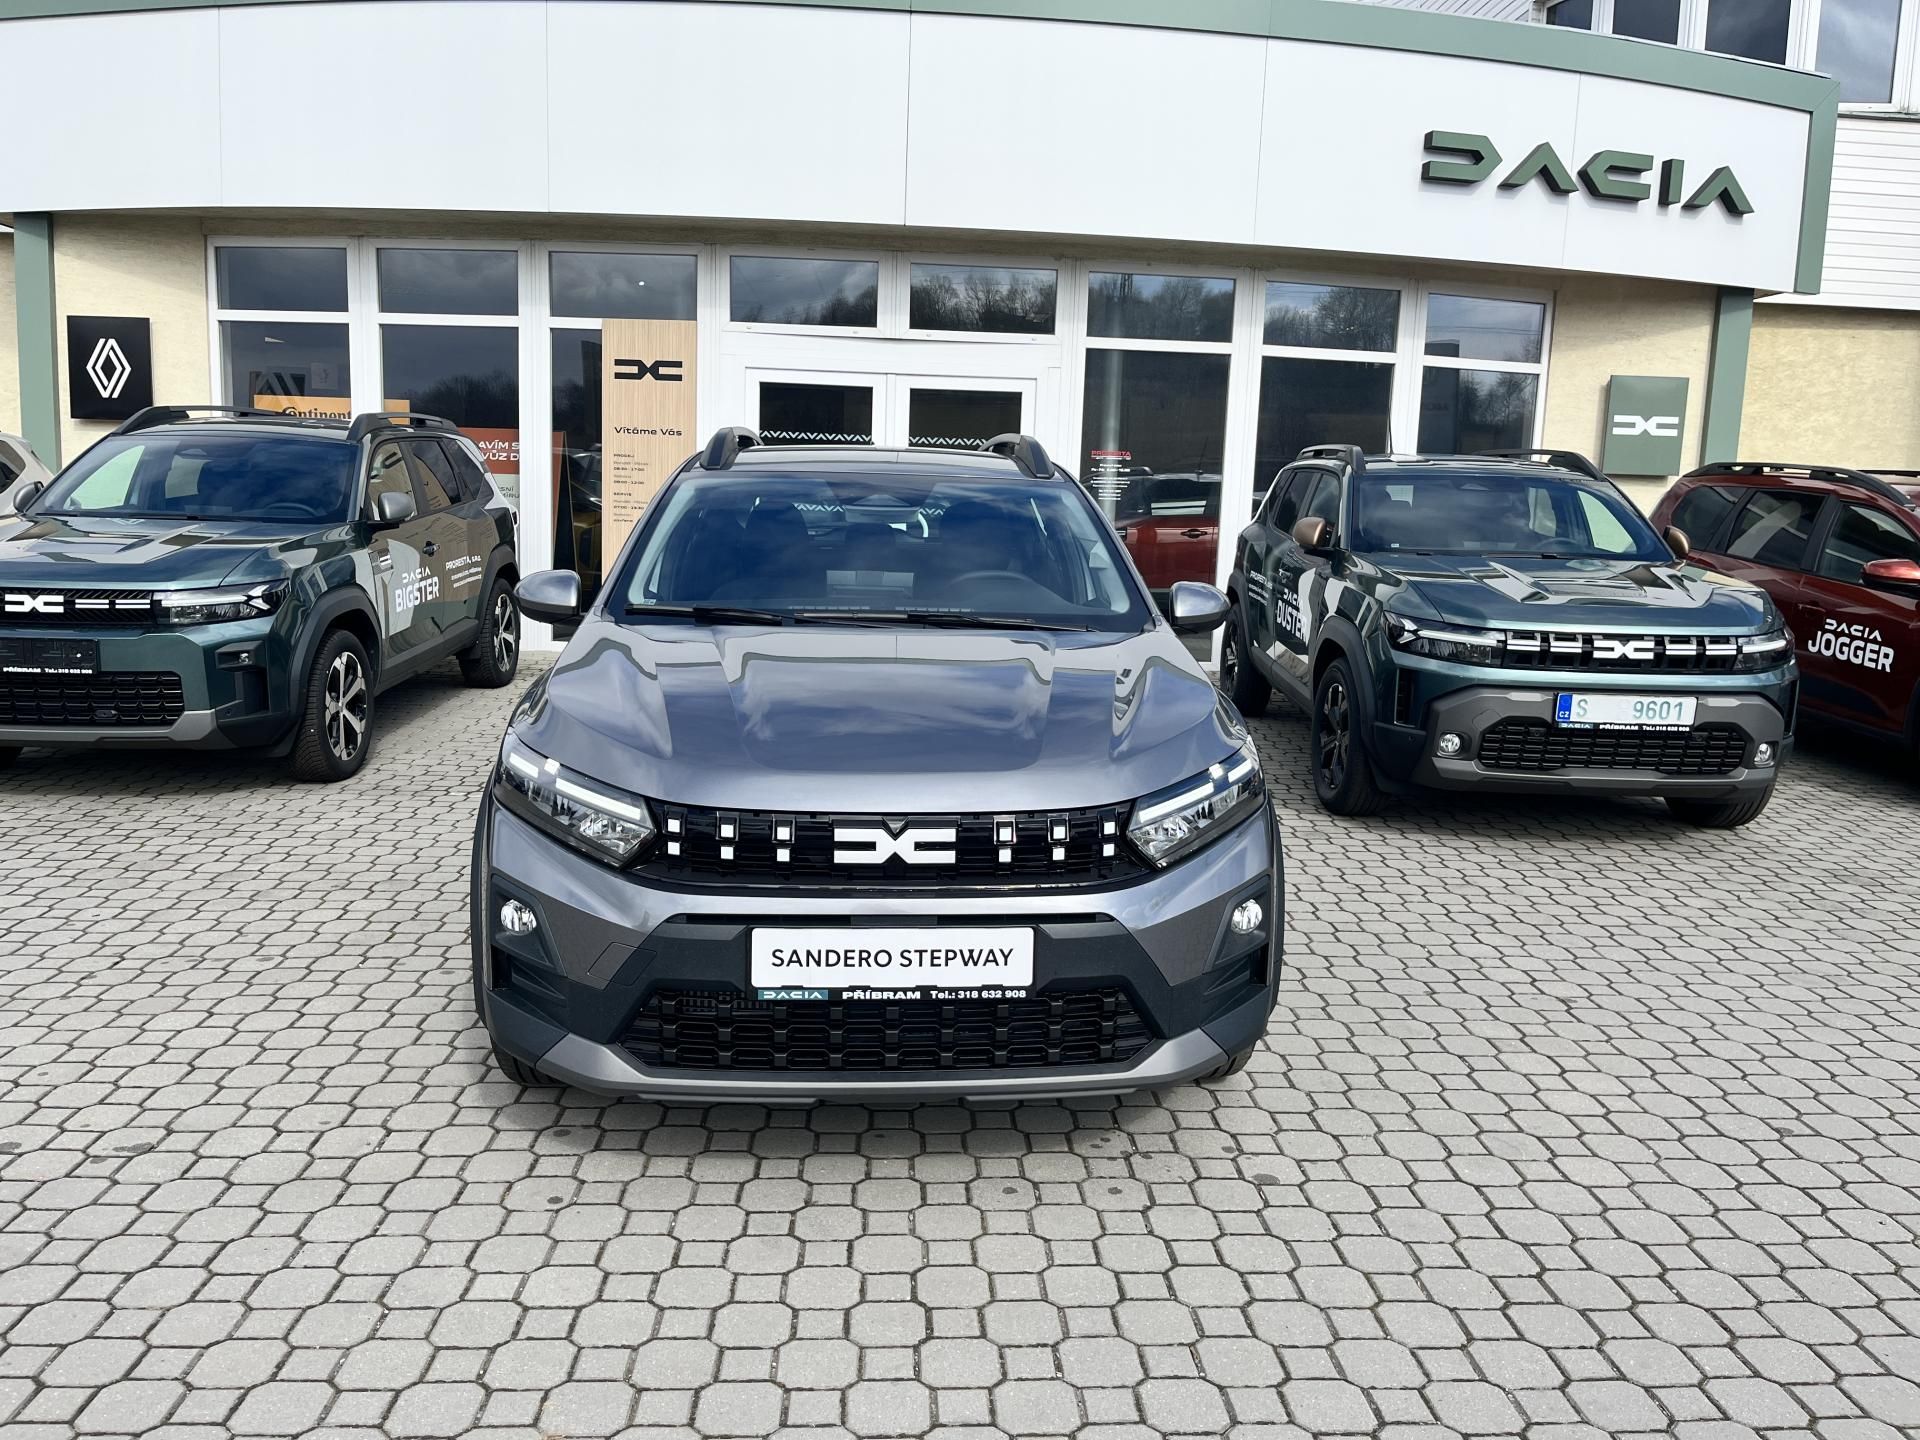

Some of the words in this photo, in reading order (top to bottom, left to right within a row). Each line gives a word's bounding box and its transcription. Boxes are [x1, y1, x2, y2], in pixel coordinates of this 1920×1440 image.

[1421, 130, 1755, 215] DACIA
[614, 426, 657, 435] Vítáme
[660, 428, 682, 436] Vás
[481, 450, 507, 460] VŮZ
[402, 566, 431, 583] DACIA
[394, 576, 440, 613] BIGSTER
[1824, 618, 1882, 641] DACIA
[1807, 630, 1894, 673] JOGGER
[1632, 700, 1684, 721] 9601
[771, 948, 893, 968] SANDERO
[899, 948, 1014, 967] STEPWAY
[763, 991, 823, 999] DACIA
[842, 990, 920, 999] PŘÍBRAM
[930, 990, 955, 999] Tel.:
[957, 990, 978, 999] 318
[981, 990, 1003, 998] 632
[1005, 989, 1026, 998] 908
